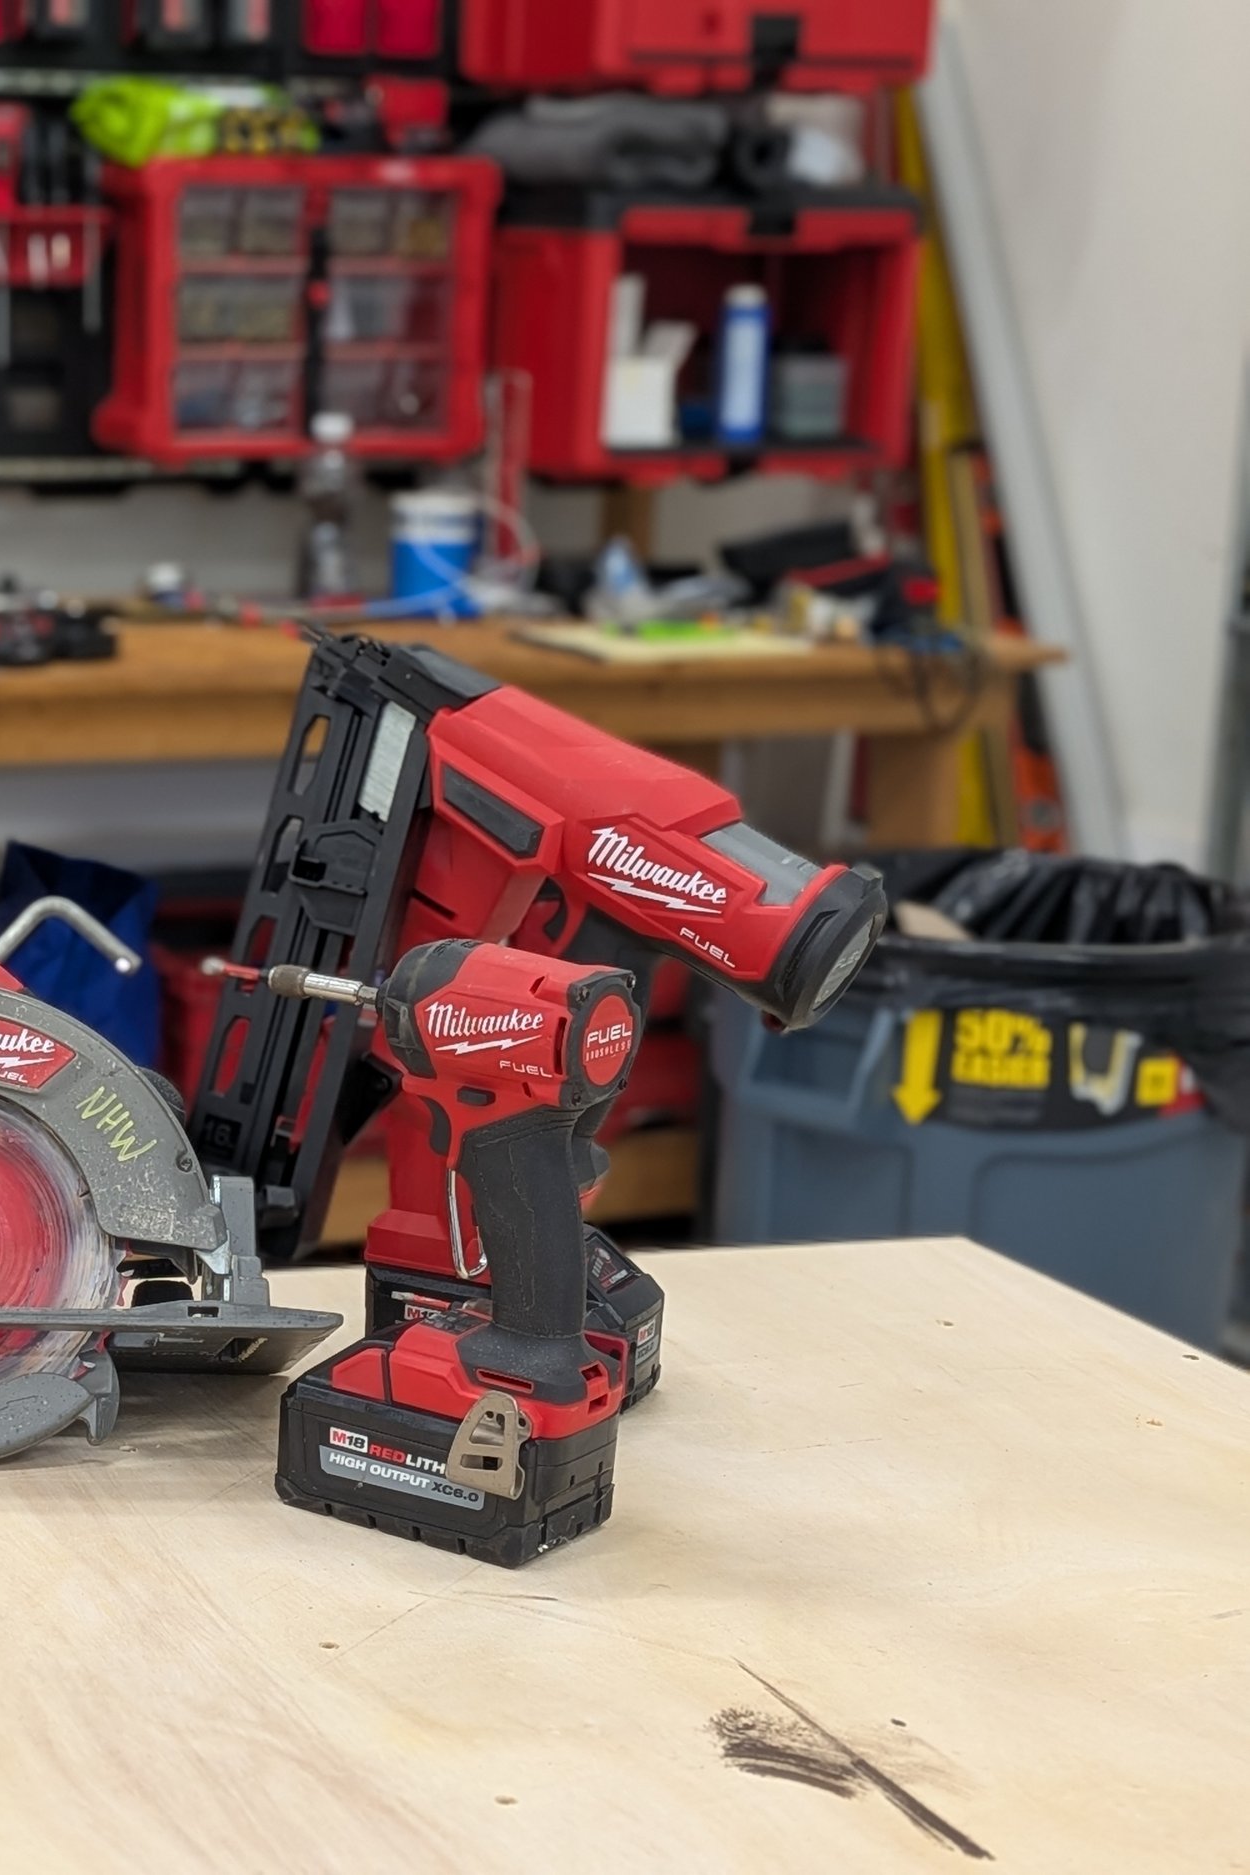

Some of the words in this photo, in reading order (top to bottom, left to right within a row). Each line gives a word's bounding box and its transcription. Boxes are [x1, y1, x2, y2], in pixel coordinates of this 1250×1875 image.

[587, 826, 727, 904] Milwaukee
[679, 926, 736, 968] FUEL
[425, 1001, 545, 1039] Milwaukee
[587, 1022, 633, 1049] FUEL
[499, 1060, 553, 1078] FUEL
[75, 1085, 158, 1162] NHW
[332, 1430, 366, 1450] M18
[369, 1443, 446, 1475] REDLITH
[329, 1452, 367, 1472] HIGH
[370, 1465, 431, 1489] OUTPUT
[431, 1481, 480, 1503] XC6.0
